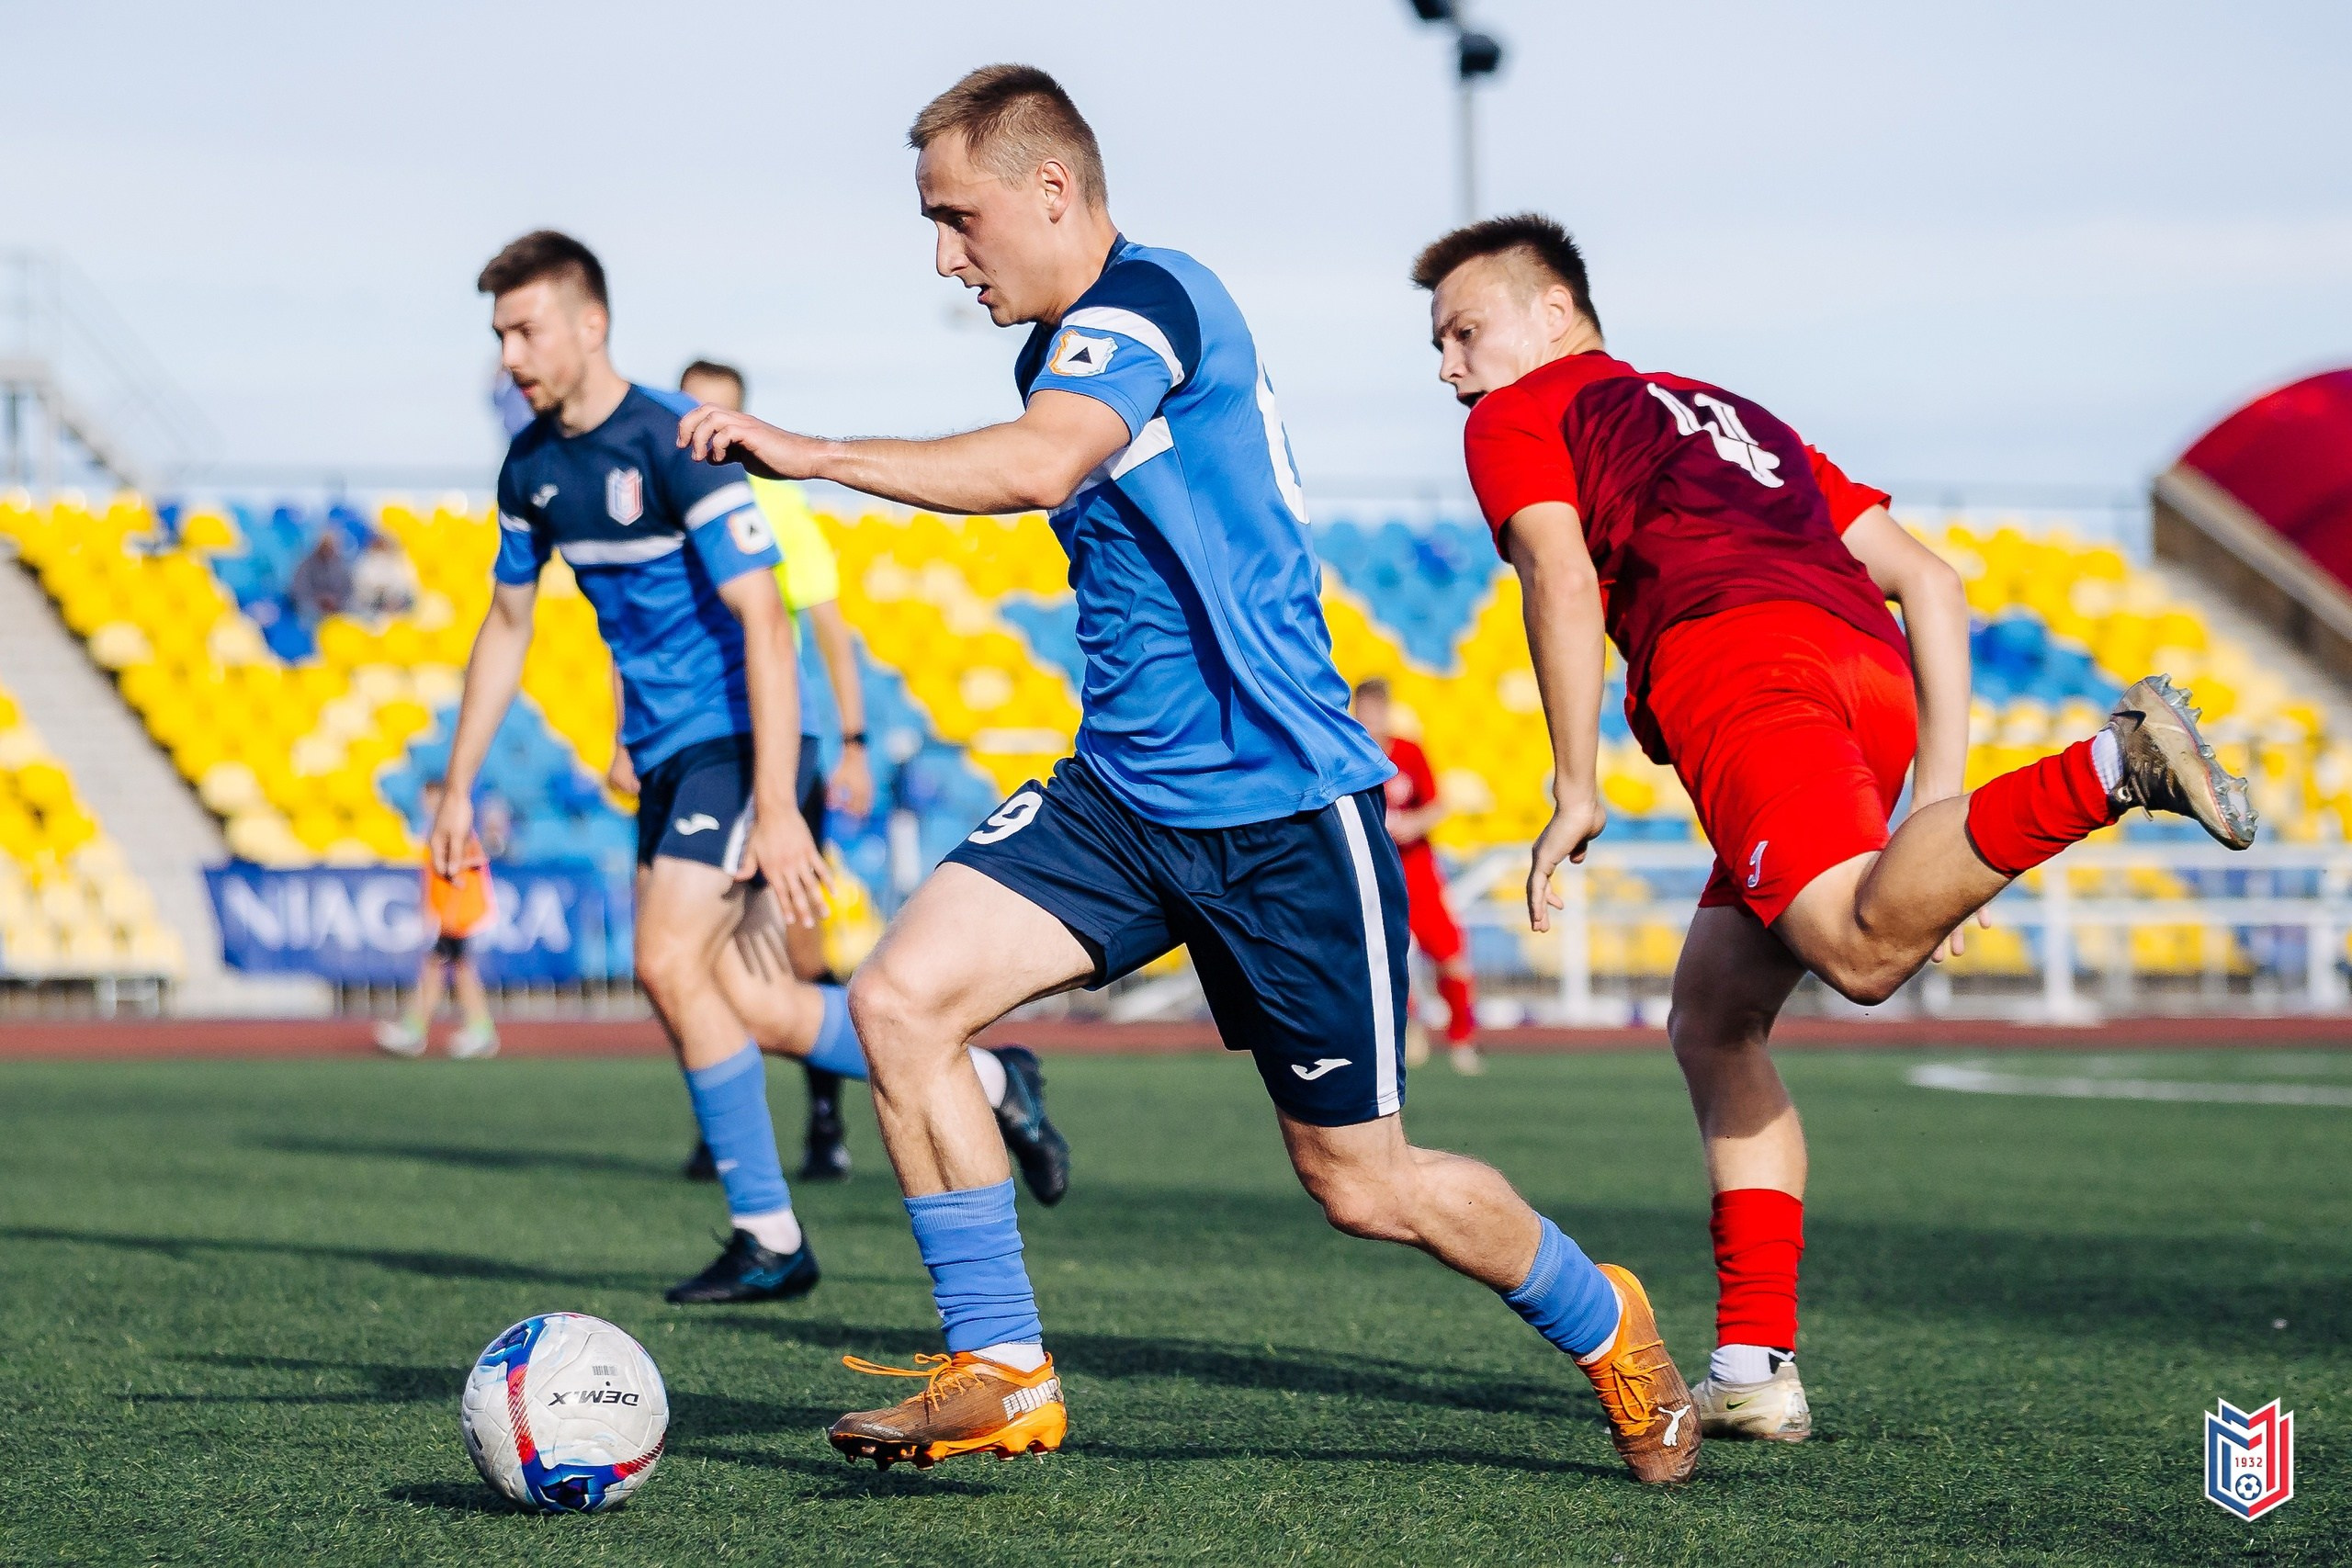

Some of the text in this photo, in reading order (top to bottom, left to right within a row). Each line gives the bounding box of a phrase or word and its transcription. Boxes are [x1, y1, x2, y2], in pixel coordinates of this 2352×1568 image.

[967, 791, 1043, 844] 9
[222, 874, 571, 953] NIAGRA
[548, 1390, 639, 1406] DEMX
